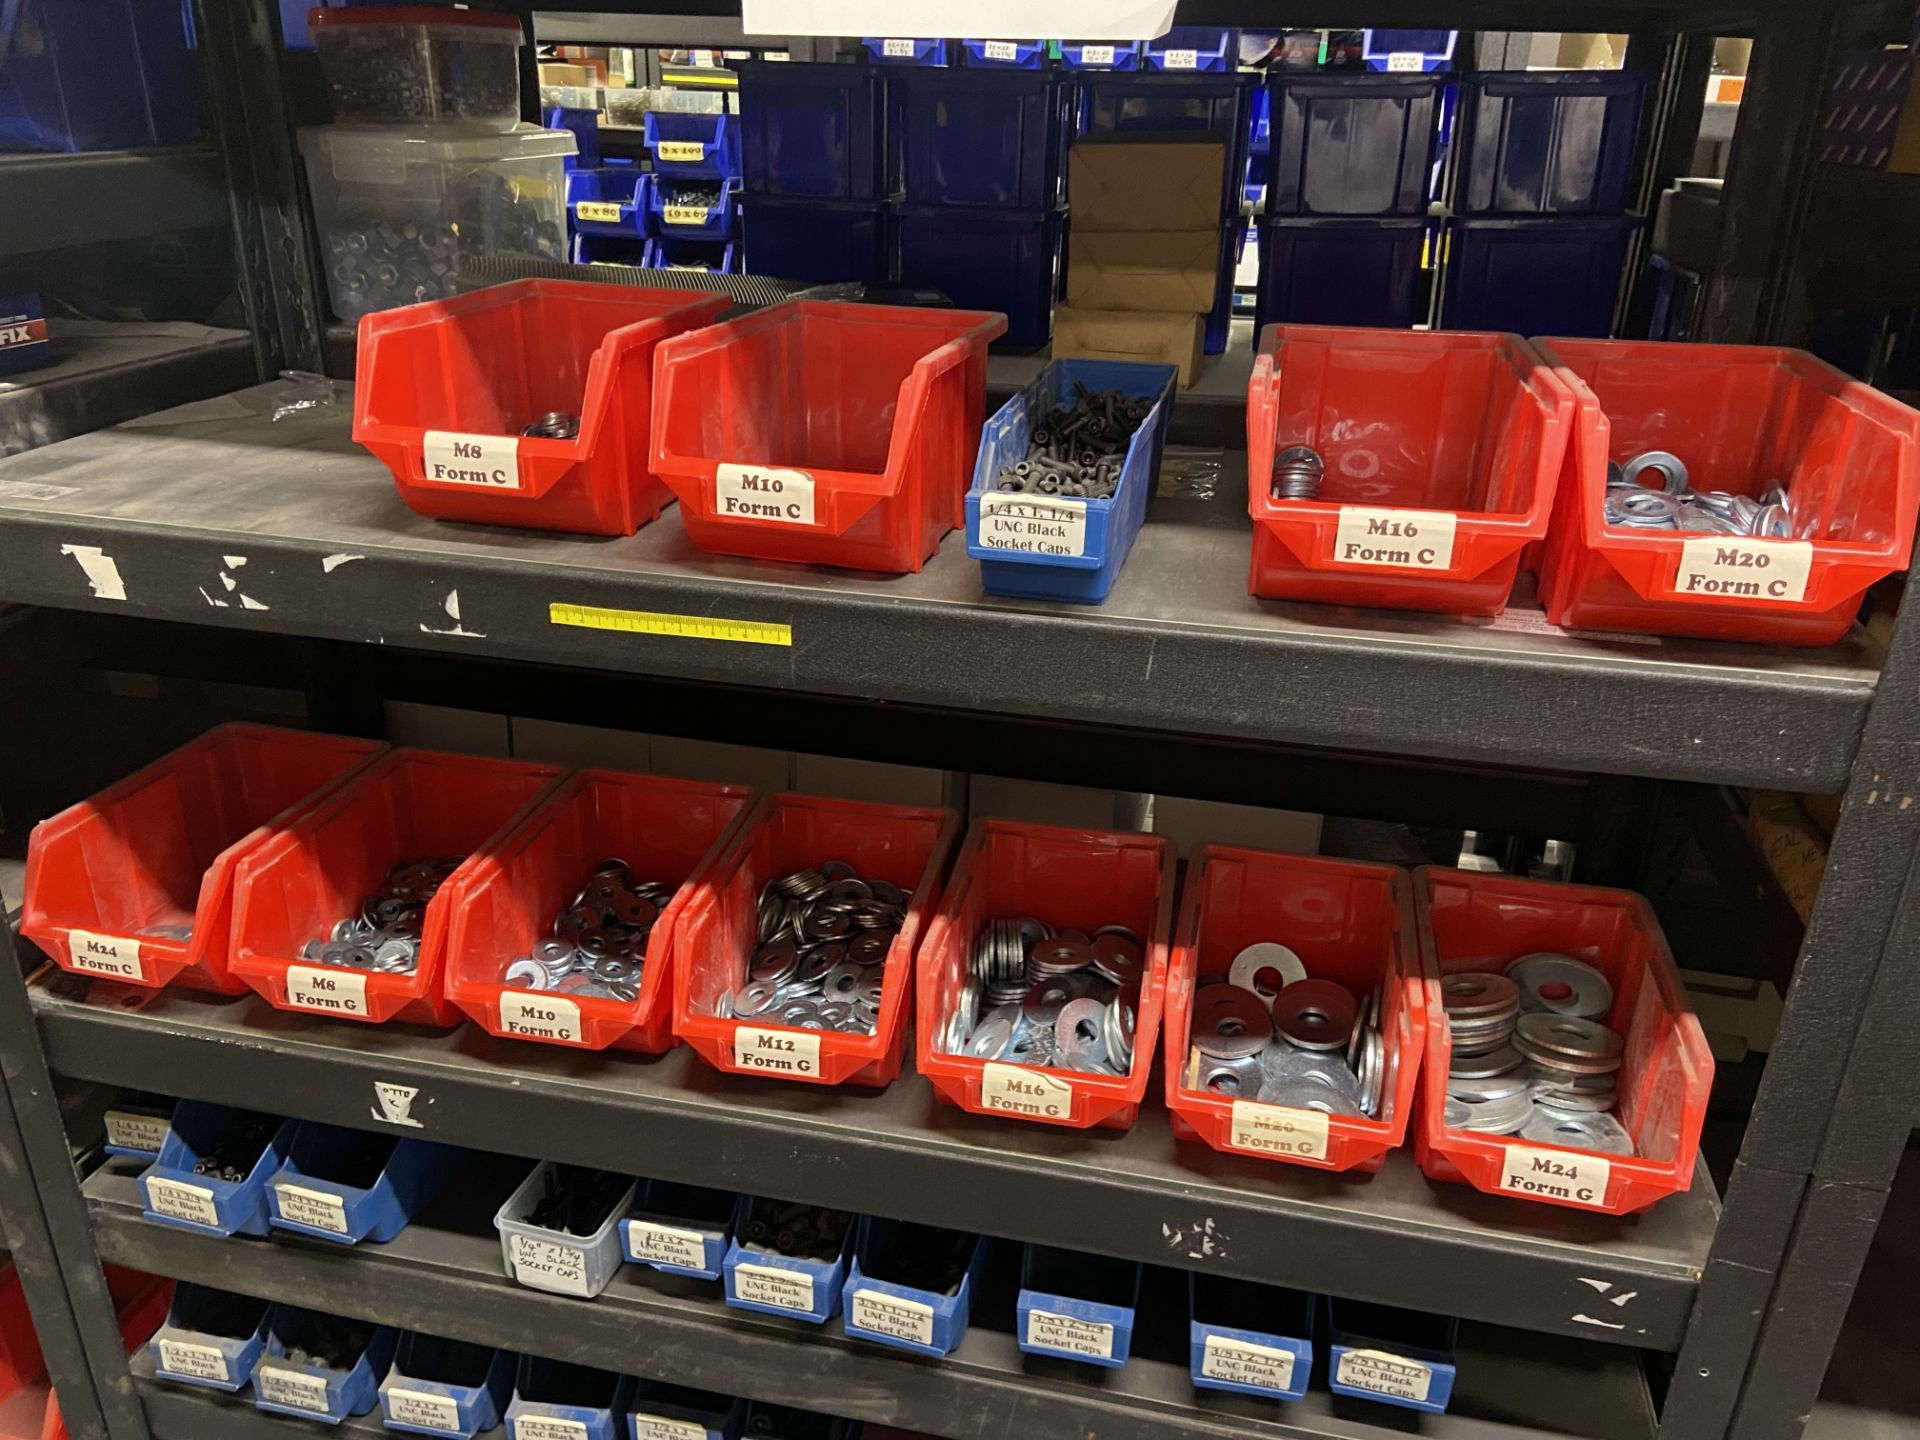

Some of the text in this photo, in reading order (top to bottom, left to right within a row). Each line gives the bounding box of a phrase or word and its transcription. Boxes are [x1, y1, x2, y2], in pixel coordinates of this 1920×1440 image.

[453, 442, 482, 459] M8
[433, 464, 506, 484] Form C
[741, 474, 784, 493] M10
[725, 496, 801, 519] Form C
[988, 503, 1012, 516] 1/4
[1018, 507, 1025, 516] x
[994, 519, 1067, 538] UNC Black
[1367, 518, 1418, 538] M16
[987, 535, 1072, 555] Socket Caps
[1344, 543, 1435, 565] Form C
[1713, 548, 1771, 569] M20
[1686, 573, 1788, 597] Form C
[87, 940, 118, 957] M24
[78, 955, 133, 975] Form C
[312, 976, 336, 991] M8
[295, 992, 357, 1010] Form G
[520, 1005, 556, 1021] M10
[507, 1021, 571, 1040] Form G
[758, 1034, 796, 1052] M12
[742, 1052, 811, 1072] Form G
[1006, 1079, 1045, 1097] M16
[989, 1095, 1060, 1116] Form G
[1254, 1115, 1295, 1133] M20
[137, 1132, 160, 1141] Black
[1237, 1132, 1313, 1154] Form G
[1531, 1157, 1578, 1180] M24
[1508, 1174, 1593, 1201] Form G
[158, 1196, 204, 1212] UNC Black
[287, 1202, 334, 1219] UNC Black
[156, 1205, 210, 1223] Socket Caps
[284, 1211, 339, 1230] Socket Caps
[640, 1239, 691, 1256] UNC Black
[519, 1249, 584, 1271] UNC BLACK
[636, 1249, 696, 1268] Socket Caps
[518, 1258, 580, 1280] SOCKET CAPS
[746, 1280, 767, 1290] UNC
[771, 1284, 799, 1296] Black
[742, 1290, 804, 1308] Socket Caps
[864, 1308, 918, 1329] UNC Black
[859, 1318, 922, 1342] Socket Caps
[1040, 1324, 1097, 1342] UNC Black
[1033, 1334, 1101, 1355] Socket Caps
[168, 1363, 197, 1373] Socket
[170, 1356, 215, 1369] UNC Black
[1216, 1358, 1276, 1378] UNC Black
[1209, 1368, 1279, 1390] Socket Caps
[1351, 1366, 1413, 1387] UNC Black
[291, 1389, 314, 1400] Black
[1344, 1375, 1416, 1398] Socket Caps
[396, 1413, 451, 1429] Socket Caps
[399, 1405, 446, 1419] UNC Black
[525, 1429, 545, 1438] UNC
